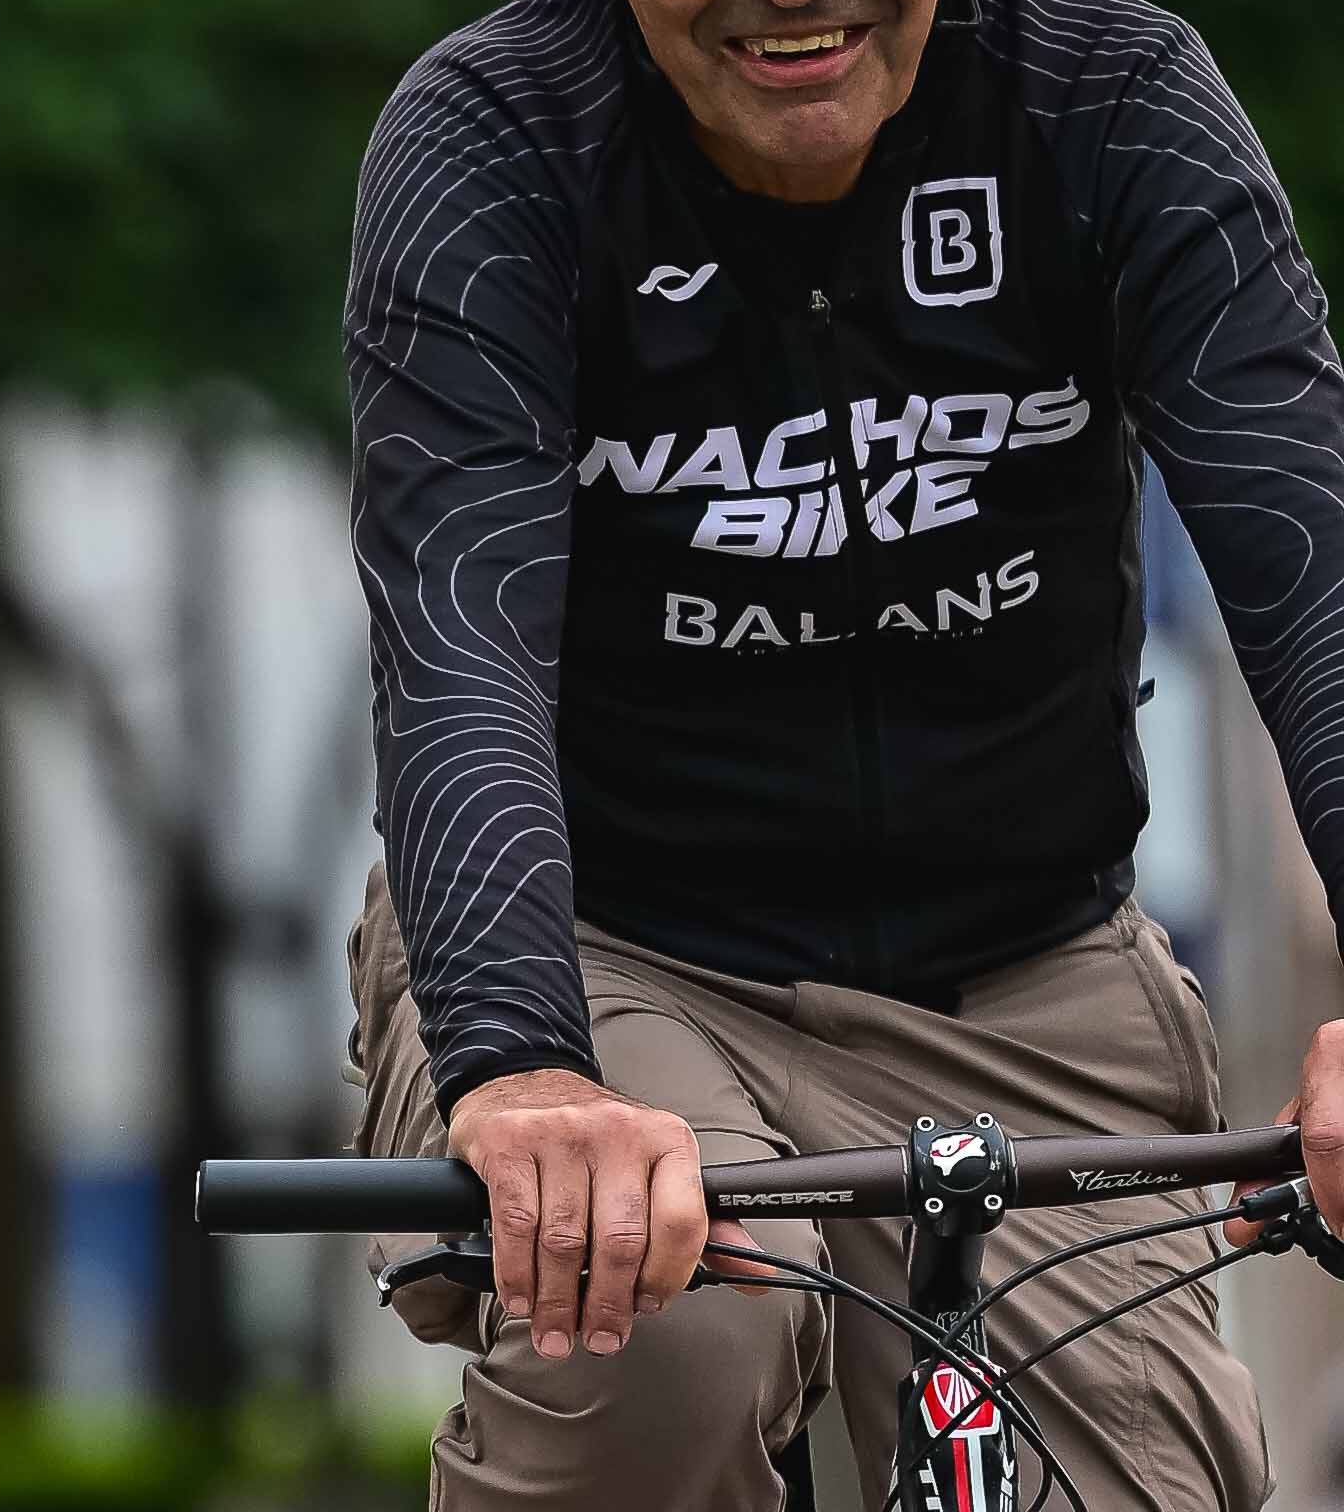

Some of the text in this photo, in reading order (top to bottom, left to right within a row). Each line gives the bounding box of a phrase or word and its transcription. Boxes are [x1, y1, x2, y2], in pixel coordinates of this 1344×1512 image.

[931, 209, 977, 276] B
[576, 377, 1090, 494] NACHOS
[690, 460, 991, 558] BIKE
